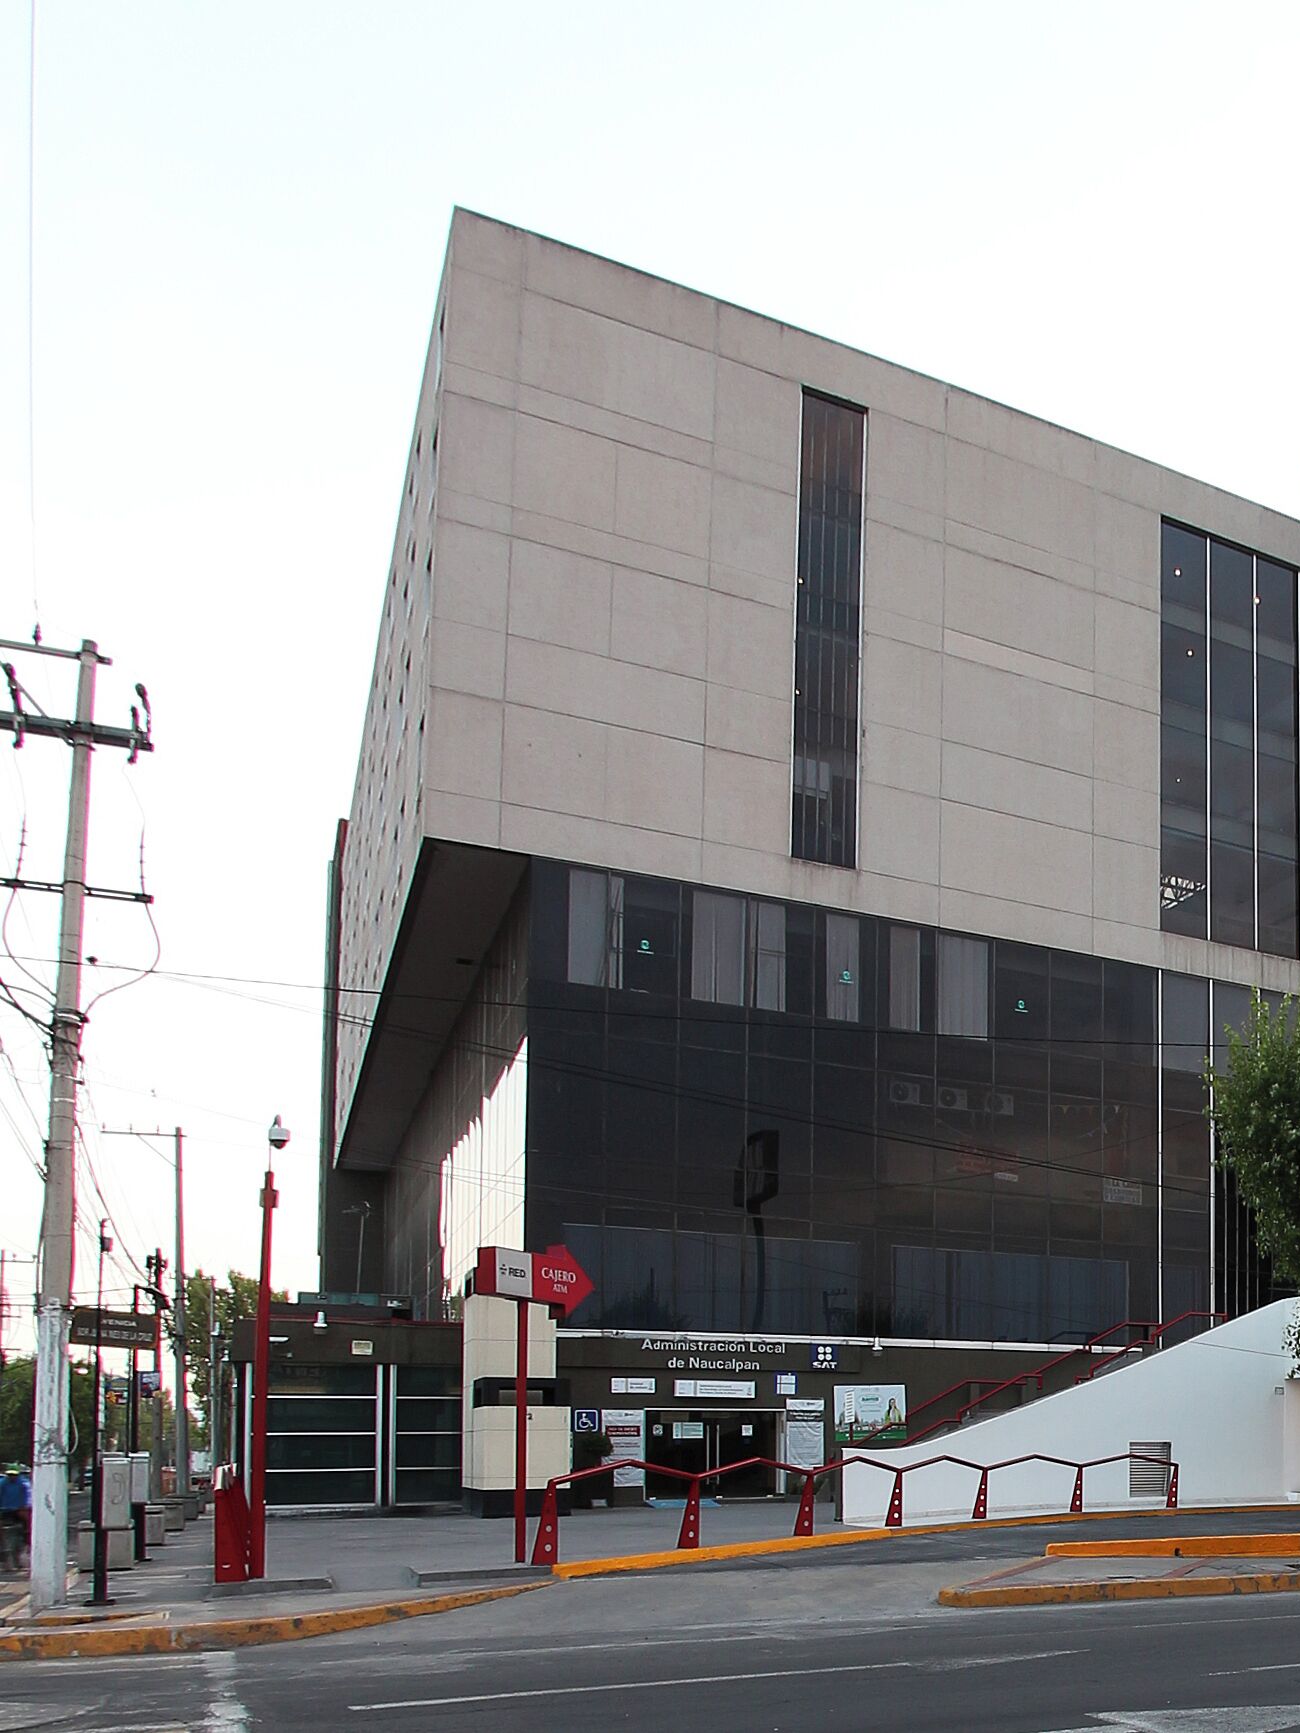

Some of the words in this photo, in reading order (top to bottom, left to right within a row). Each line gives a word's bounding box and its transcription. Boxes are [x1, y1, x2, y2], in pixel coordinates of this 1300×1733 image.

[508, 1267, 526, 1279] RED
[541, 1267, 577, 1284] CAJERO
[553, 1283, 569, 1294] ATM
[641, 1338, 746, 1353] Administración
[749, 1340, 786, 1354] Local
[667, 1356, 684, 1369] de
[689, 1357, 760, 1373] Naucalpan
[812, 1361, 838, 1369] SAT
